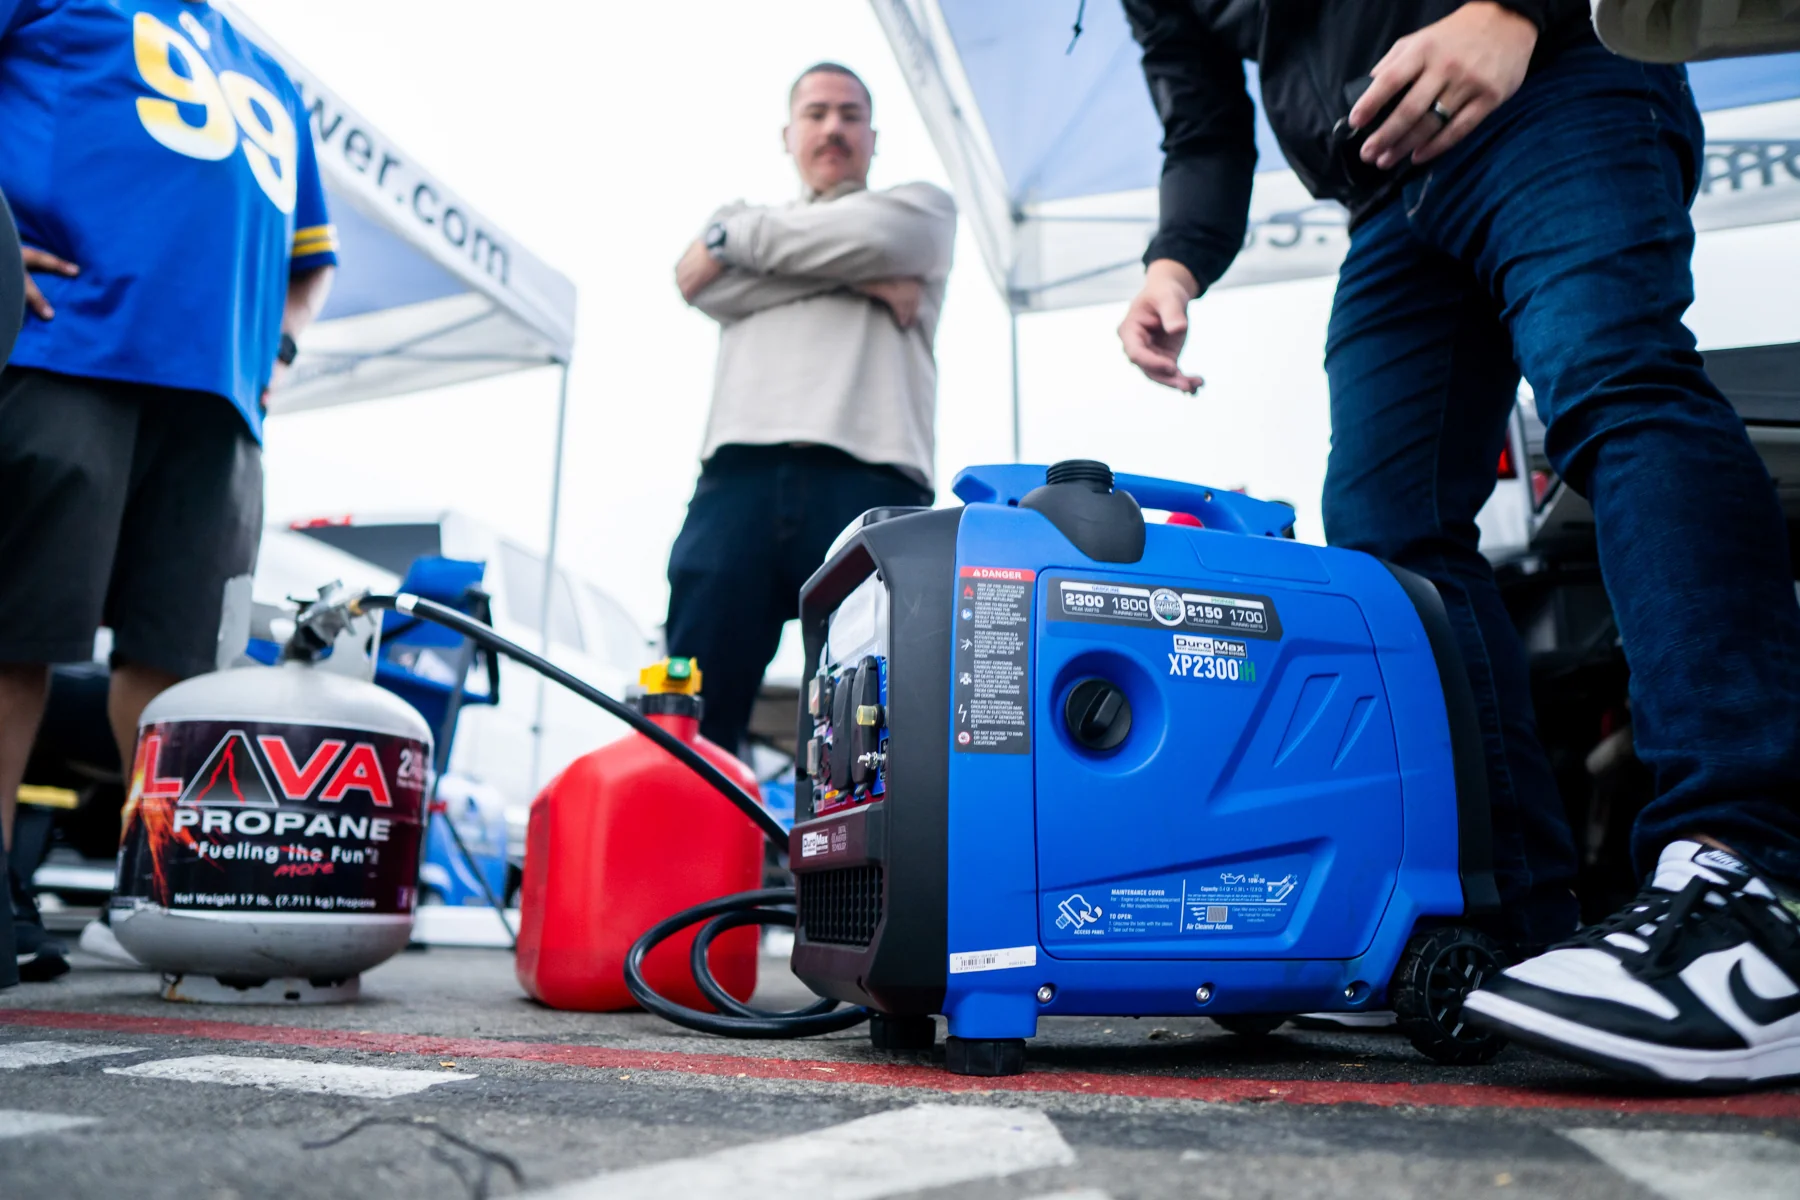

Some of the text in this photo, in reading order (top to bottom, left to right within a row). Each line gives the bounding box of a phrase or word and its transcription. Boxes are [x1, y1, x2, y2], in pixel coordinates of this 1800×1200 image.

[133, 12, 297, 214] 99
[982, 569, 1022, 580] DANGER
[1065, 593, 1104, 608] 2300
[1112, 597, 1148, 611] 1800
[1187, 605, 1222, 619] 2150
[1230, 609, 1262, 623] 1700
[1168, 653, 1256, 682] XP2300iH
[143, 729, 392, 807] LAVA
[172, 808, 392, 842] PROPANE
[274, 862, 334, 878] more
[174, 893, 192, 904] Net
[196, 893, 236, 906] Weight
[240, 894, 254, 905] 17
[256, 894, 273, 906] lb.
[315, 894, 334, 909] kg)
